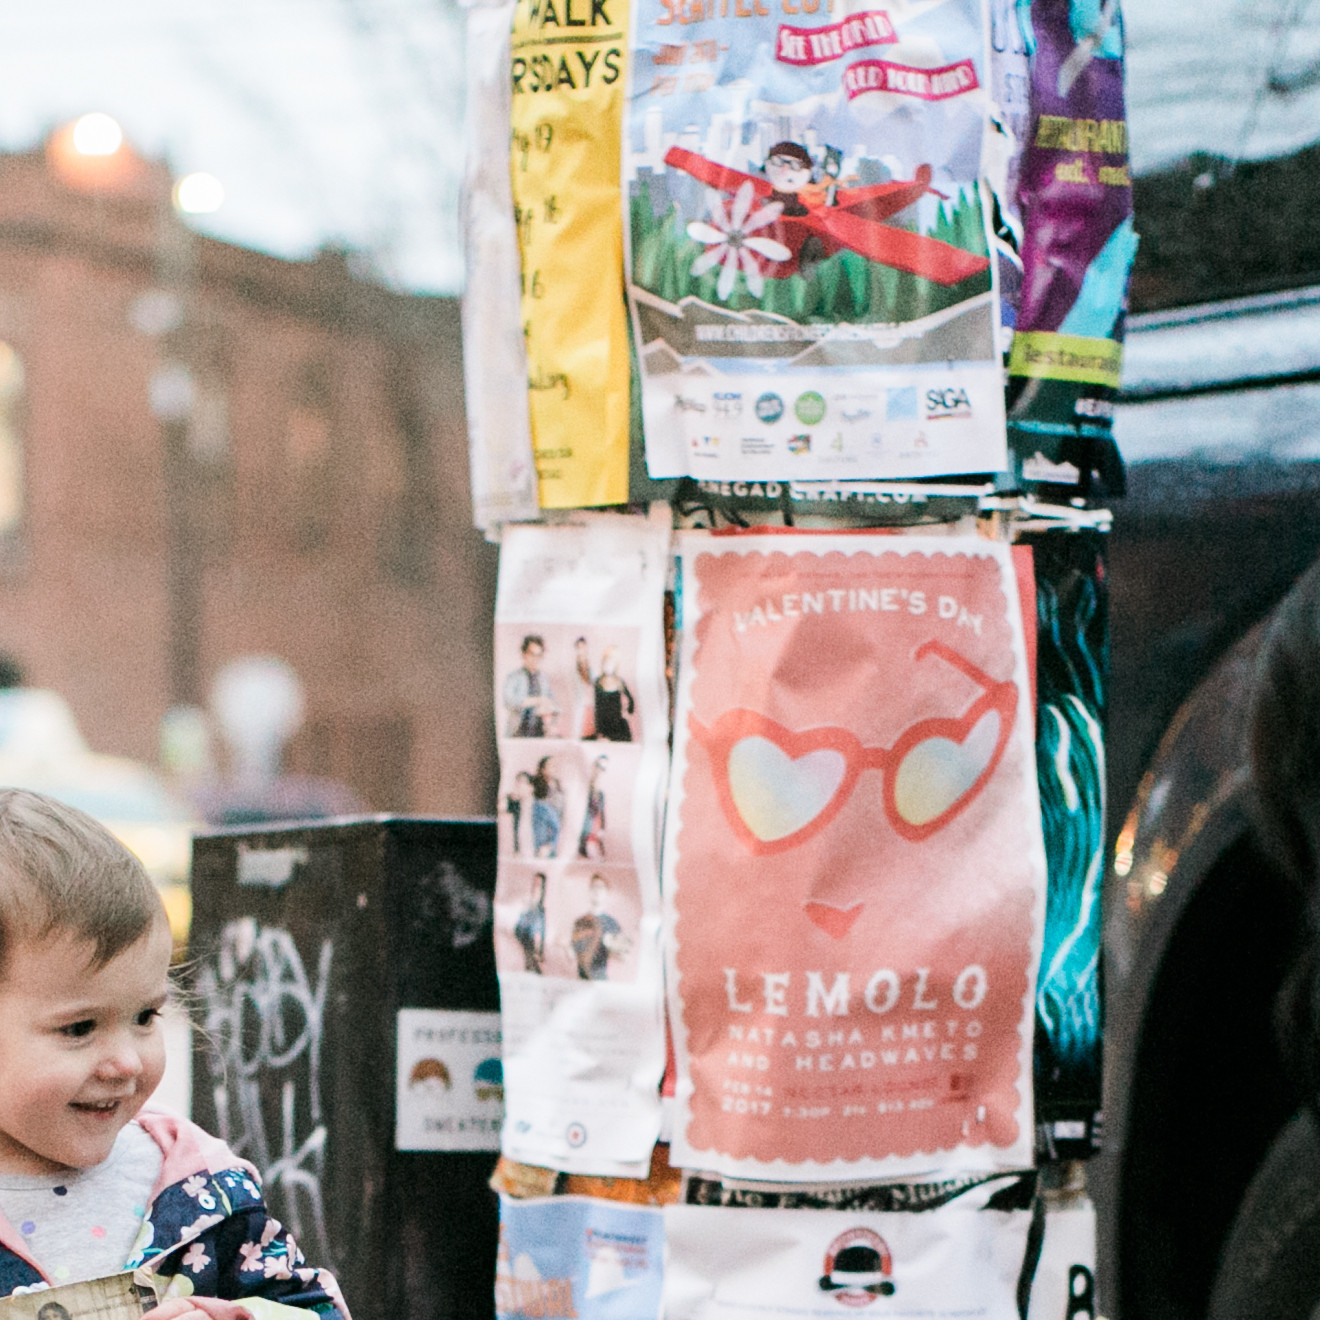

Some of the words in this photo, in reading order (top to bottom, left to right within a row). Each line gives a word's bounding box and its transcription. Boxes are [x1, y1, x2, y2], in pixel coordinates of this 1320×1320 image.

[733, 587, 927, 633] VALENTINE'S
[937, 595, 984, 635] DAY
[723, 963, 988, 1018] LEMOLO
[729, 1023, 864, 1049] NATASHA
[882, 1019, 982, 1043] KMETO
[728, 1052, 771, 1072] AND
[795, 1042, 979, 1072] HEADWAVES
[721, 1097, 773, 1116] 2017
